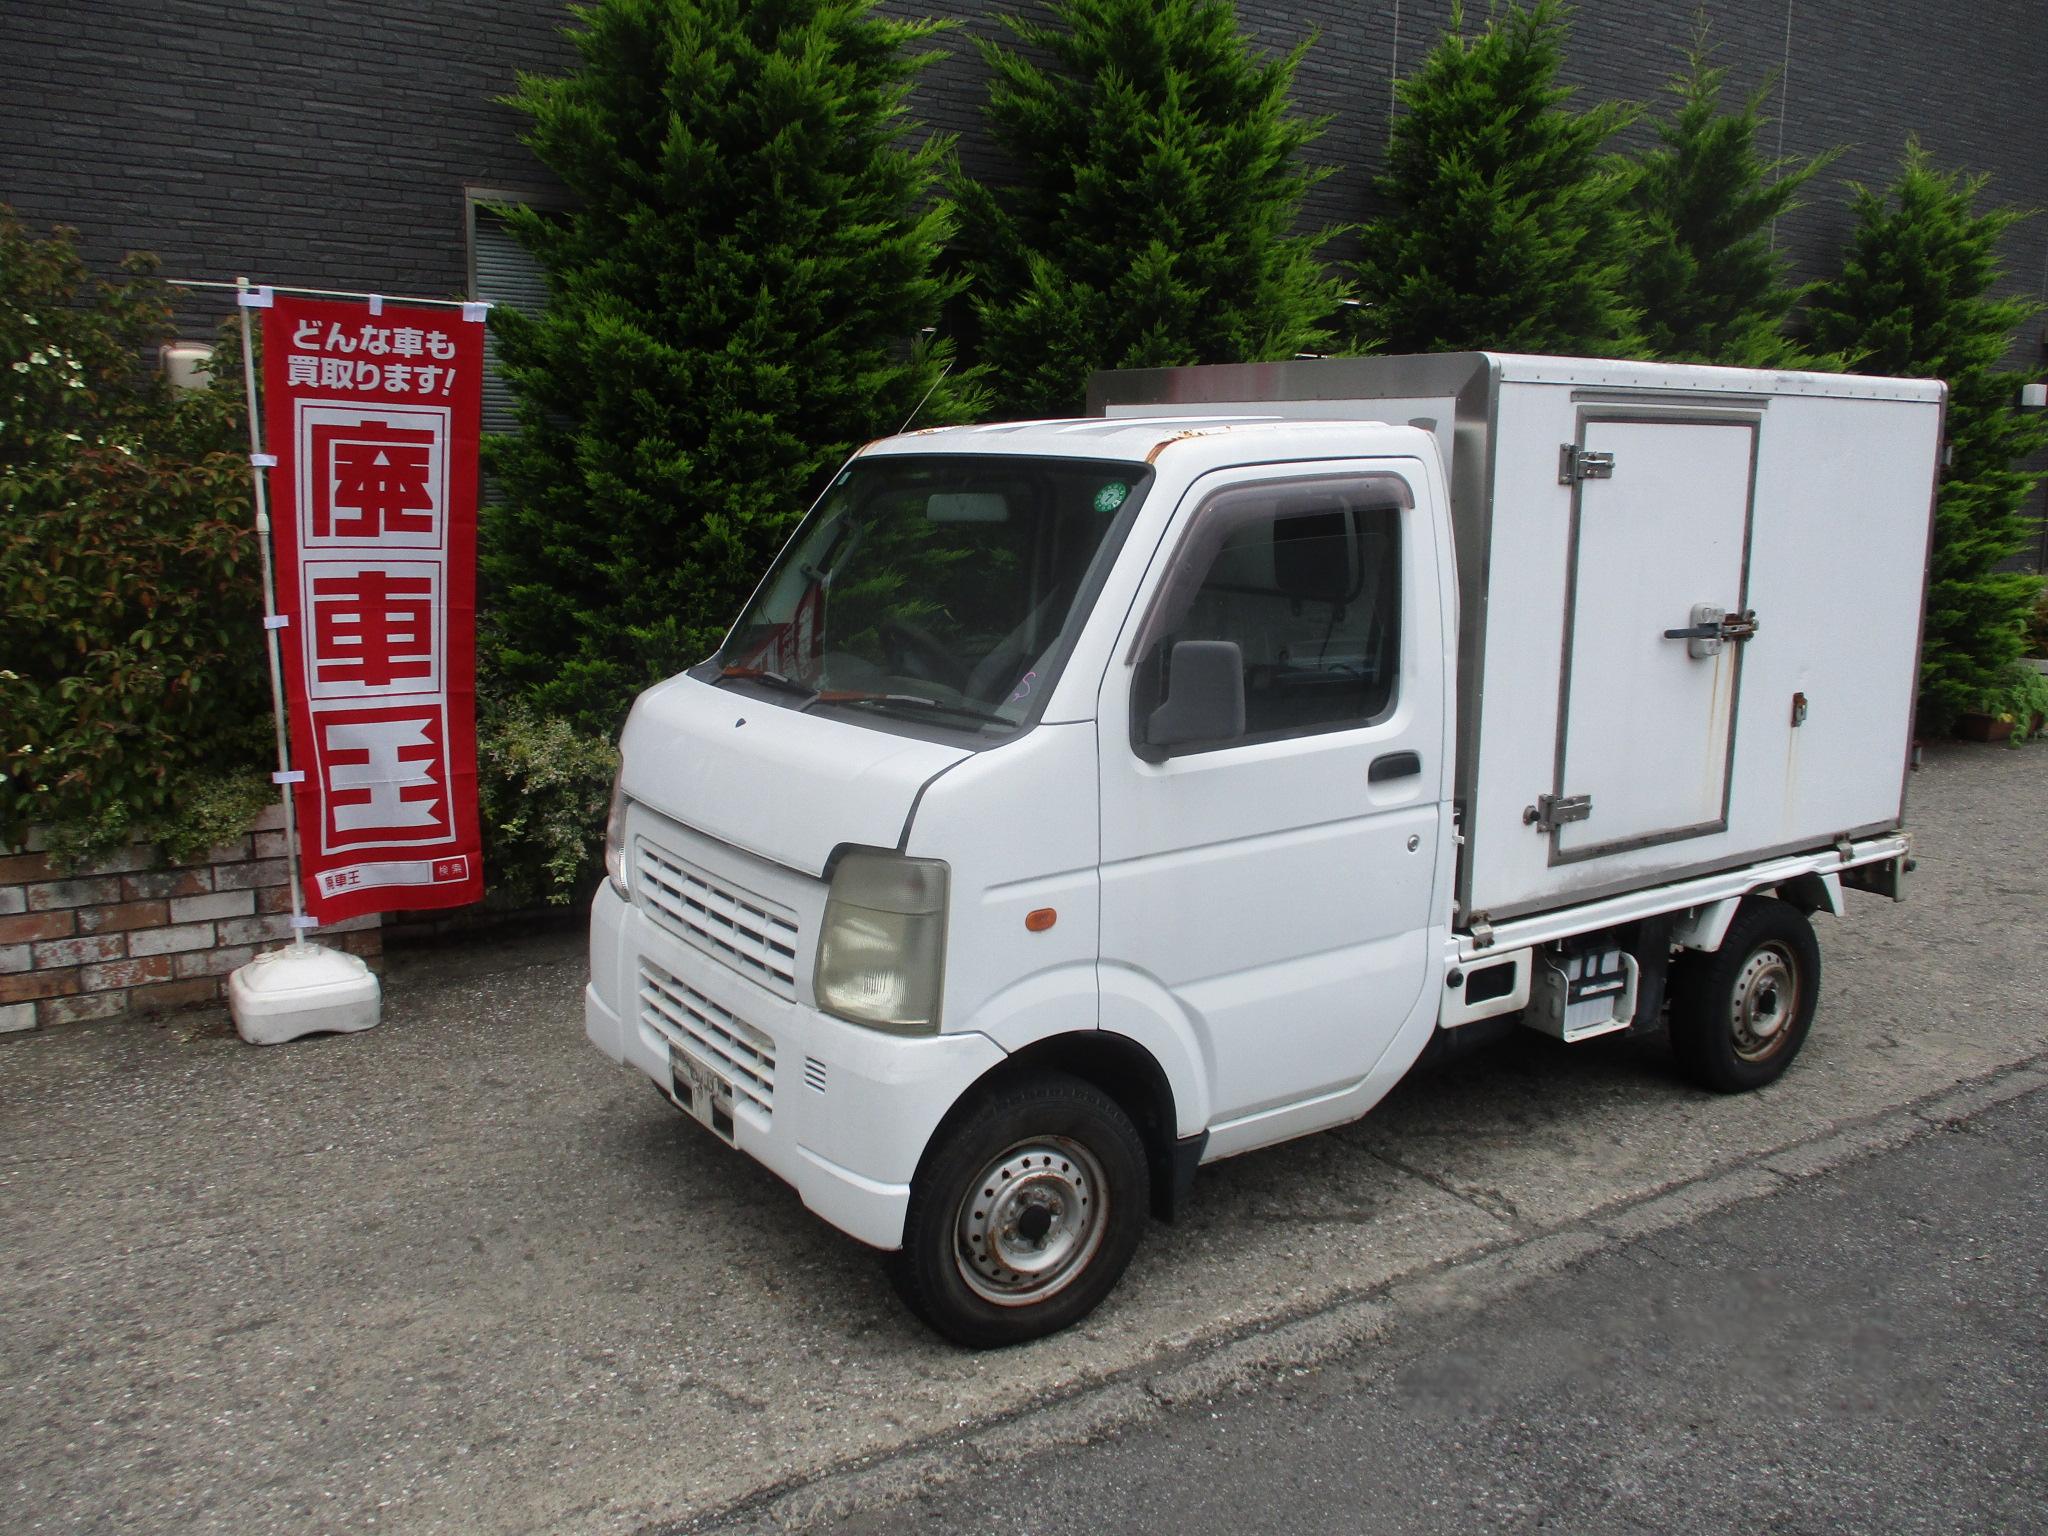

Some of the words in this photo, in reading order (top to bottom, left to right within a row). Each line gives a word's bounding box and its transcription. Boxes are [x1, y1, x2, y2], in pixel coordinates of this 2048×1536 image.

[292, 319, 456, 360] どんな車も
[287, 354, 456, 396] 買取ります!
